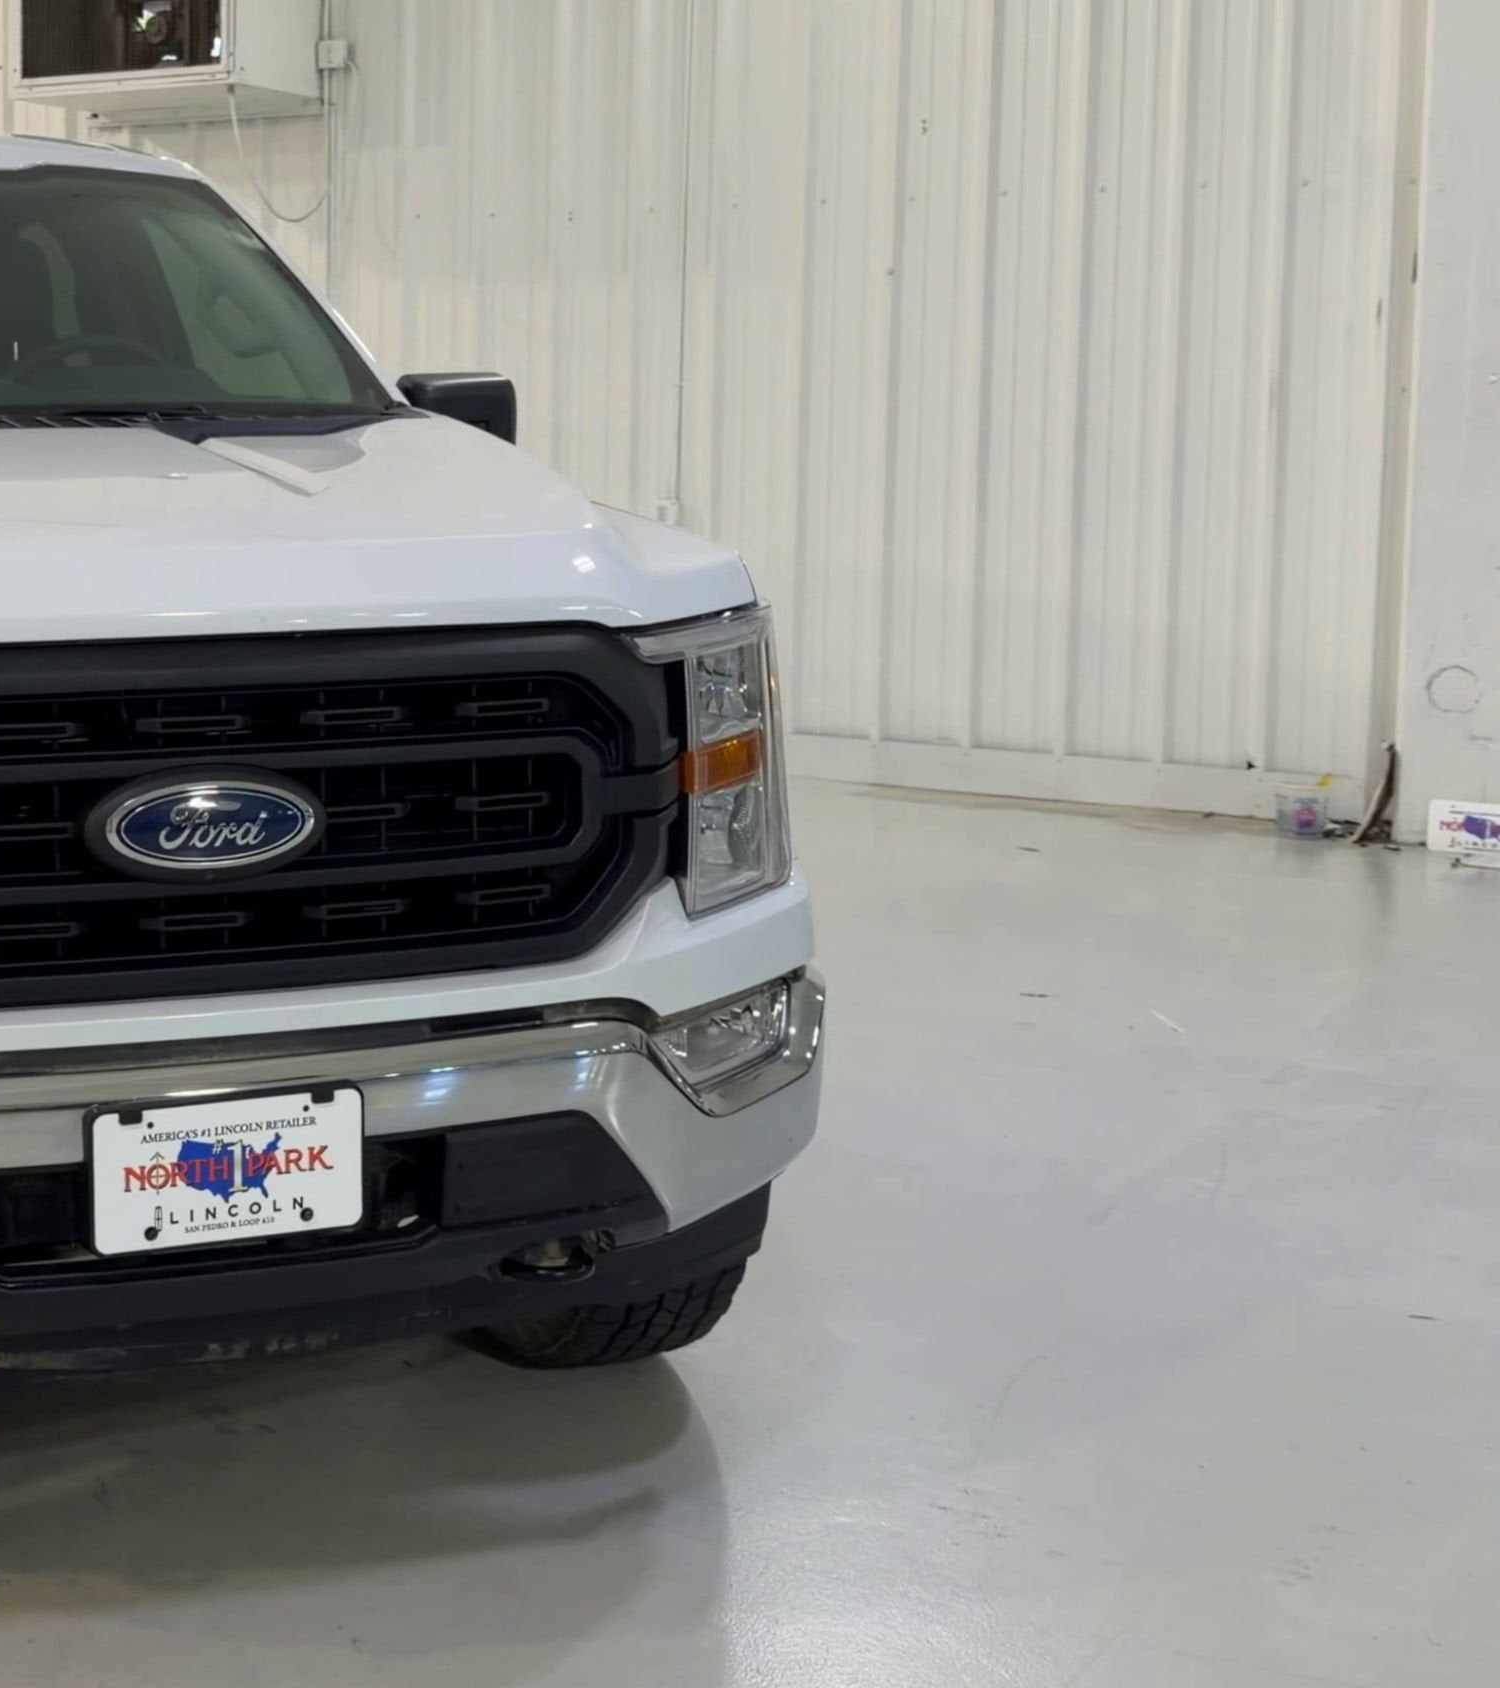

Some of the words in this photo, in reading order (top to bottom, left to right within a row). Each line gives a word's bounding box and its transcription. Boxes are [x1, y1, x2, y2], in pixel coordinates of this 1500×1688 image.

[158, 797, 266, 850] Ford
[141, 1128, 198, 1144] AMERICA'S
[200, 1127, 211, 1138] #1
[215, 1121, 263, 1136] LINCOLN
[266, 1116, 317, 1130] RETAILER
[124, 1156, 229, 1193] NORTH
[247, 1145, 334, 1178] PARK
[170, 1197, 304, 1225] LINCOLN
[184, 1225, 200, 1234] SAN
[202, 1221, 229, 1231] PEDRO
[230, 1220, 237, 1228] &
[238, 1217, 260, 1227] LOOP
